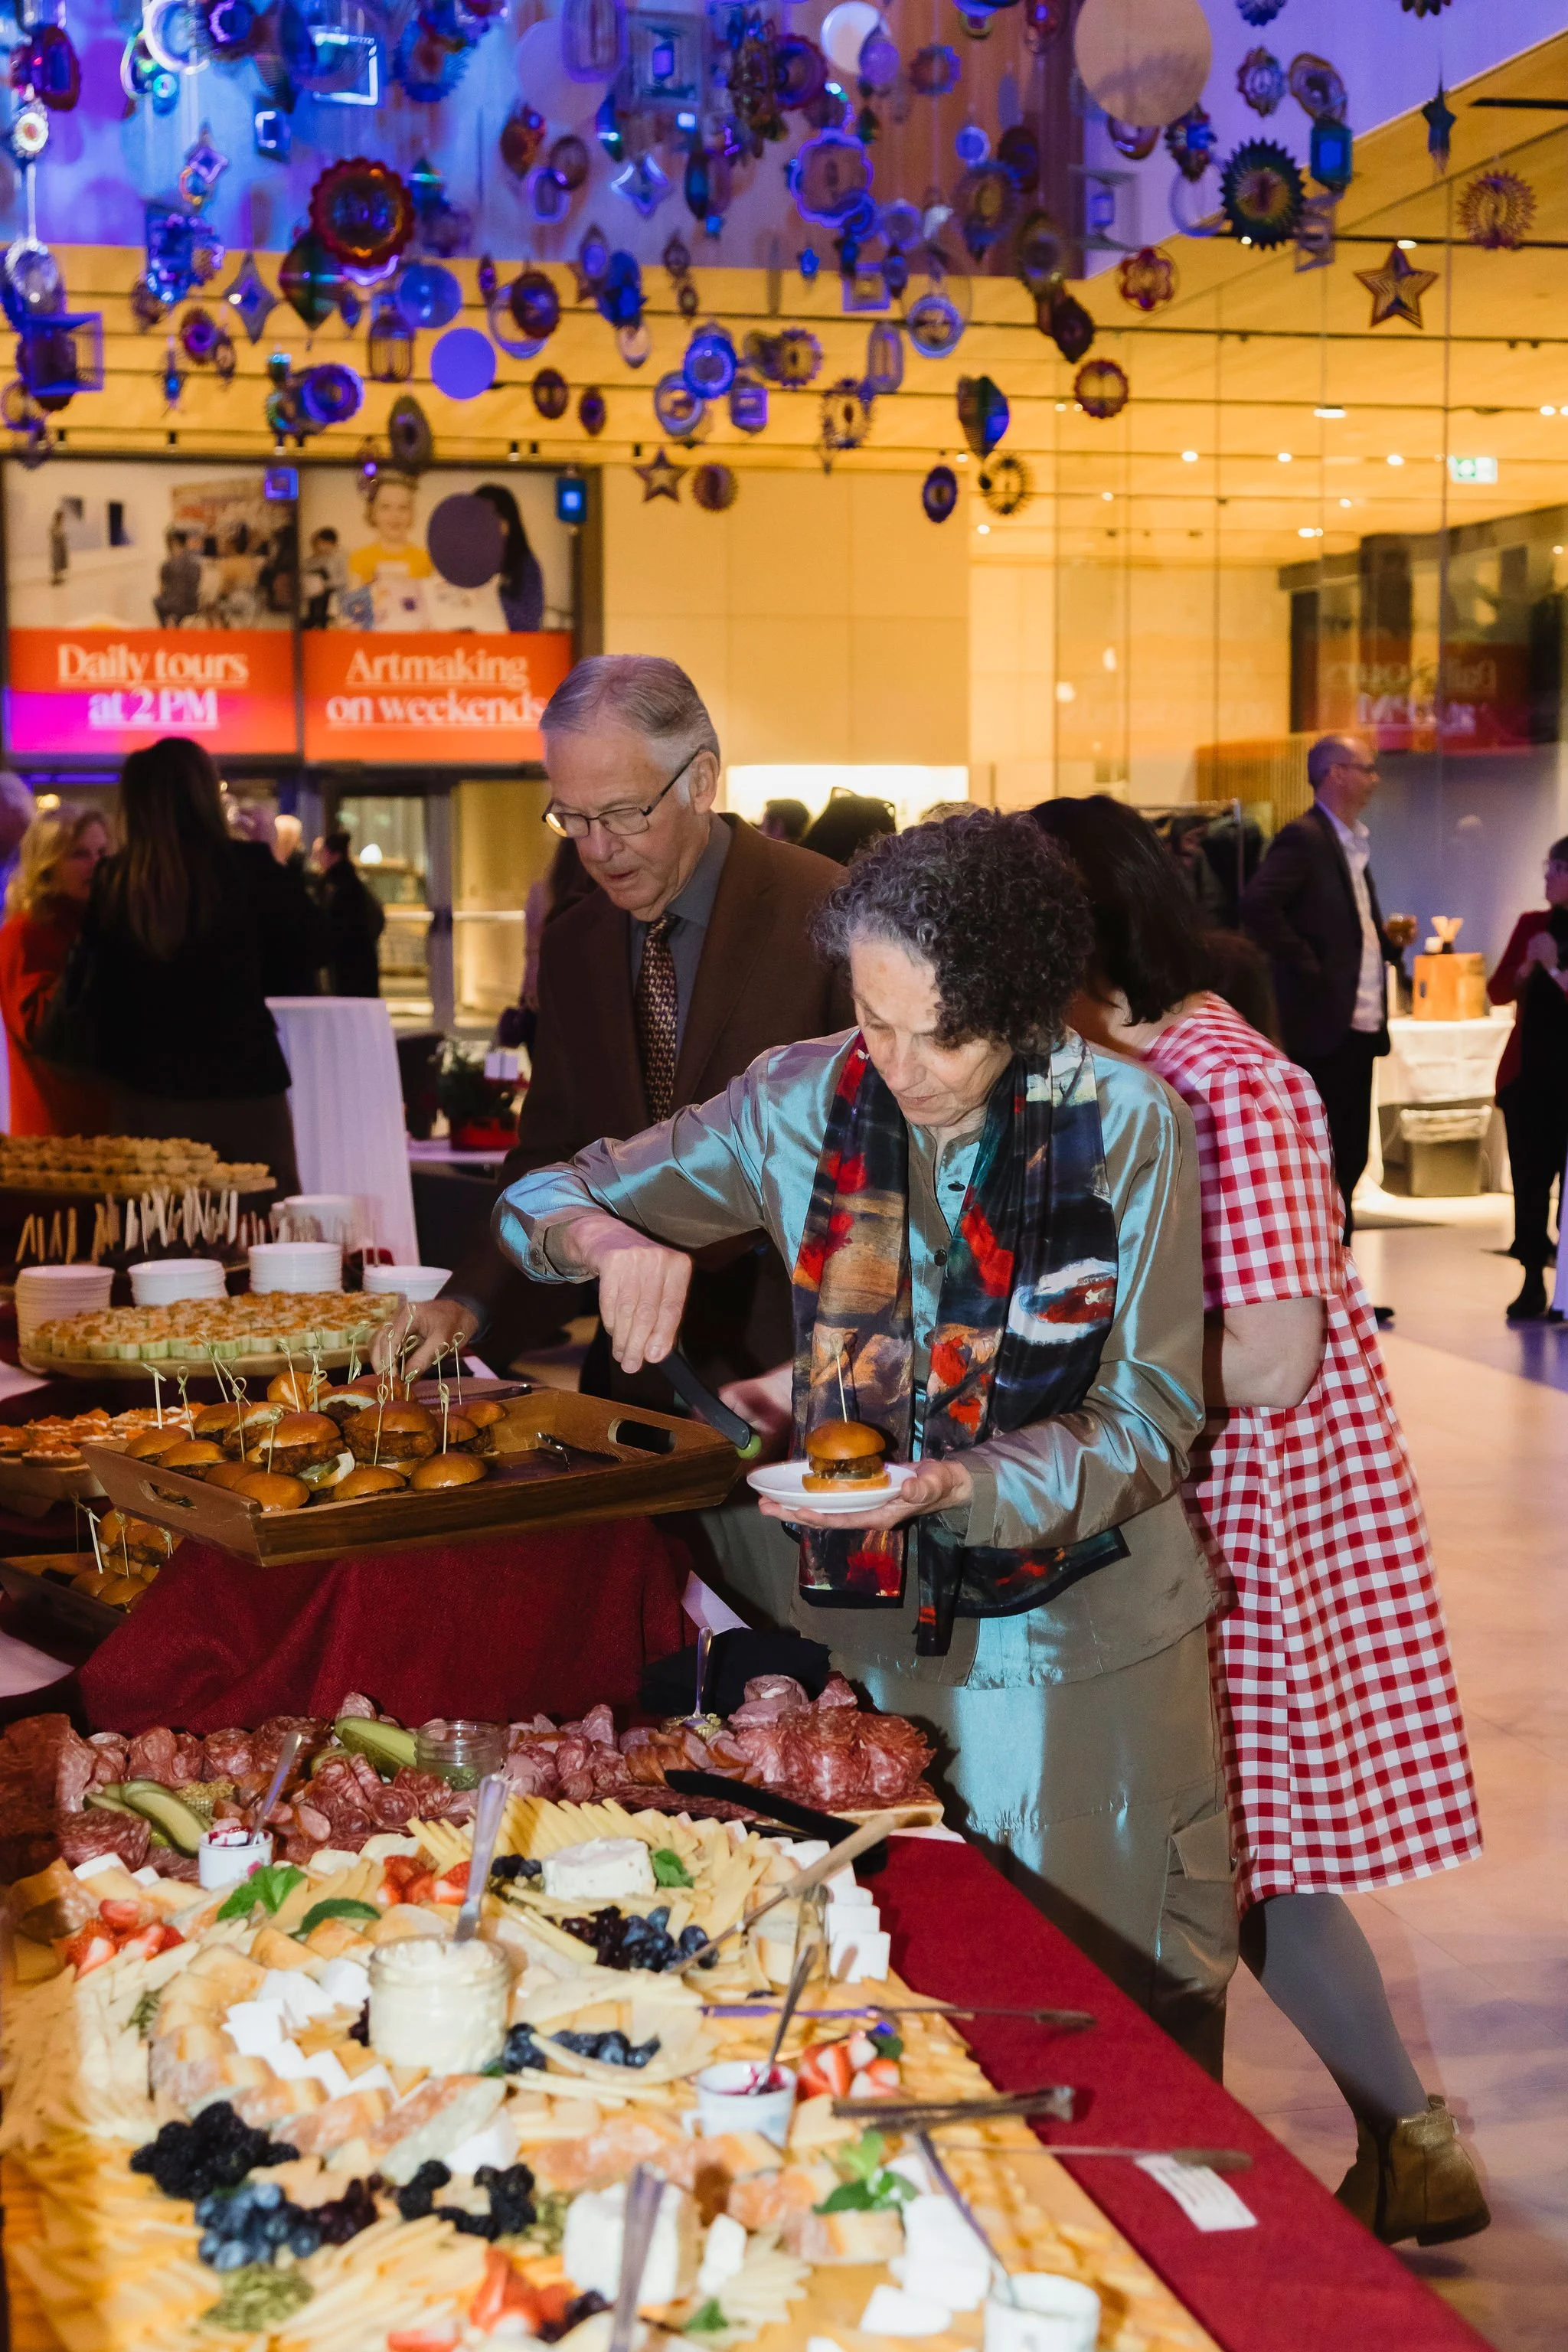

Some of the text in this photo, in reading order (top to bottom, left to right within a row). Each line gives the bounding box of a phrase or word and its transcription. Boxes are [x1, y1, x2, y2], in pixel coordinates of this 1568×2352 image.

[57, 643, 250, 688] Daily tours
[345, 648, 530, 692] Artmaking
[88, 686, 218, 724] at 2 PM
[326, 688, 548, 723] on weekends
